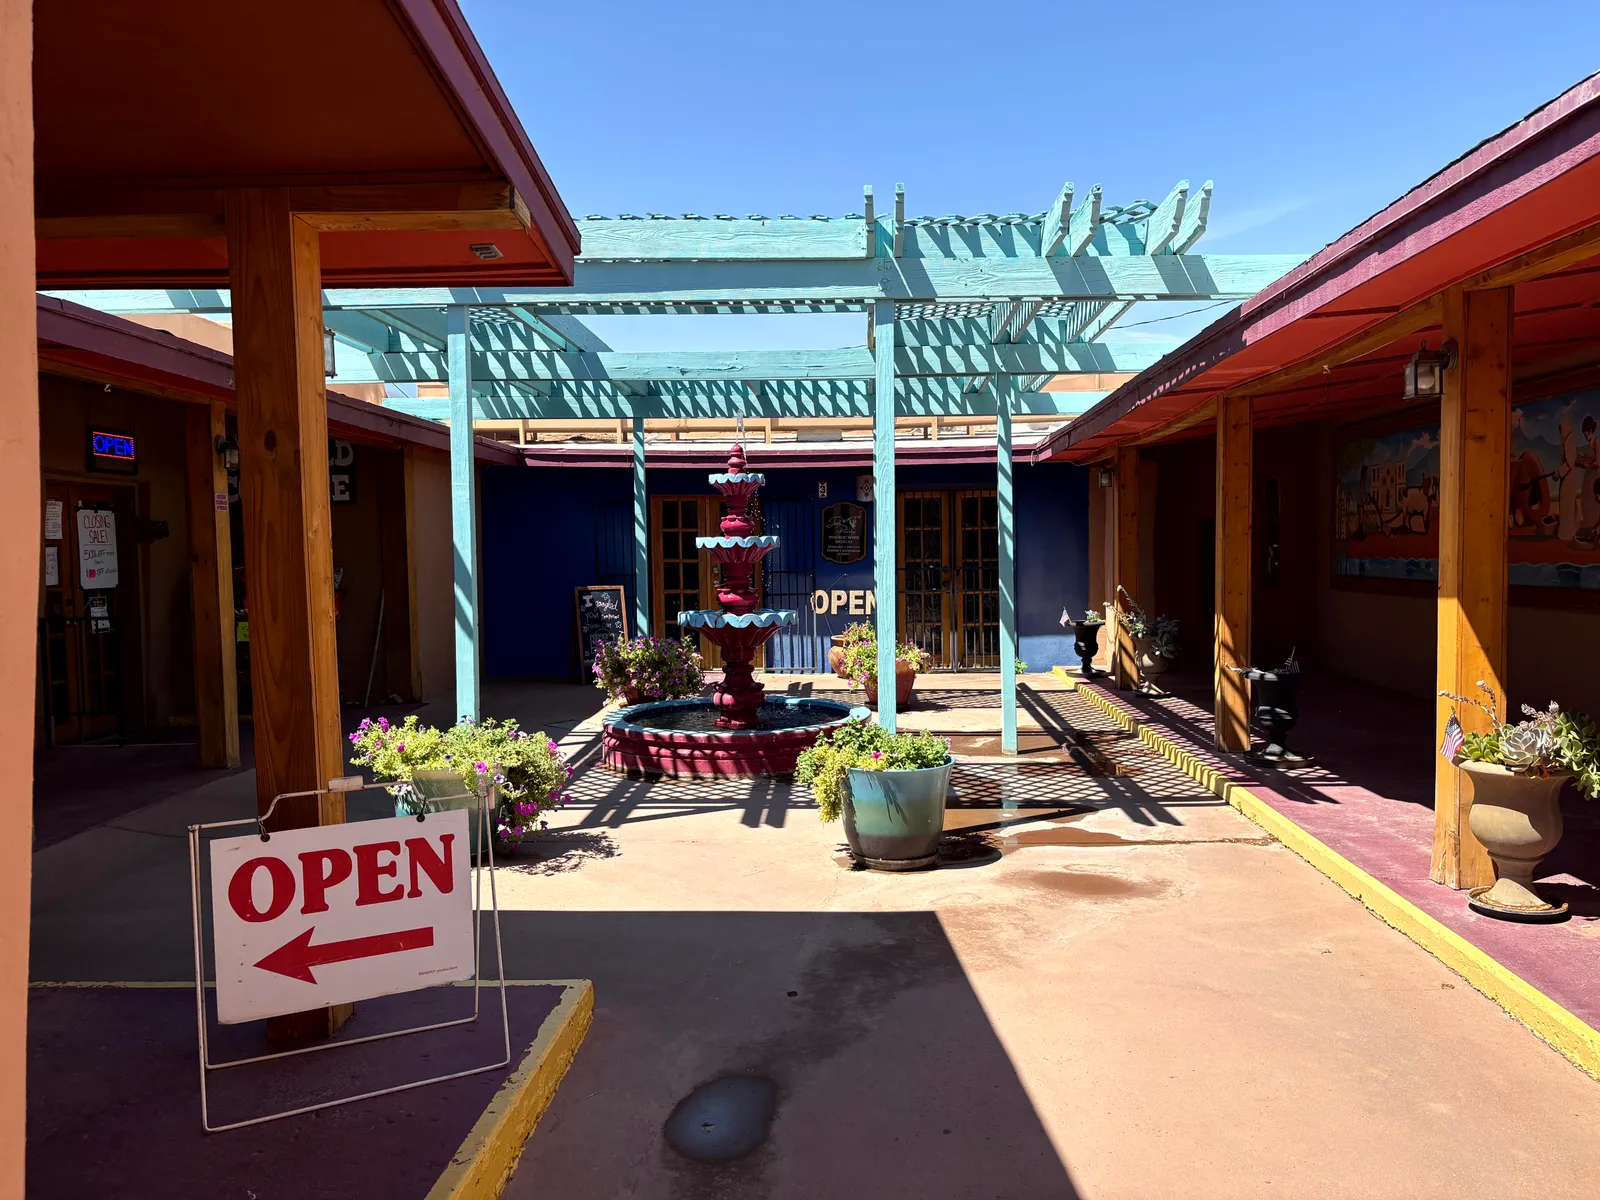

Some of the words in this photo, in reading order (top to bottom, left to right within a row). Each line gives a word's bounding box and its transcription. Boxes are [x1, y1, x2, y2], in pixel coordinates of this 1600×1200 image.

[94, 435, 133, 457] OPEN
[84, 514, 111, 529] CLOSING
[89, 529, 109, 543] SALE!
[582, 594, 593, 608] I
[228, 833, 455, 923] OPEN
